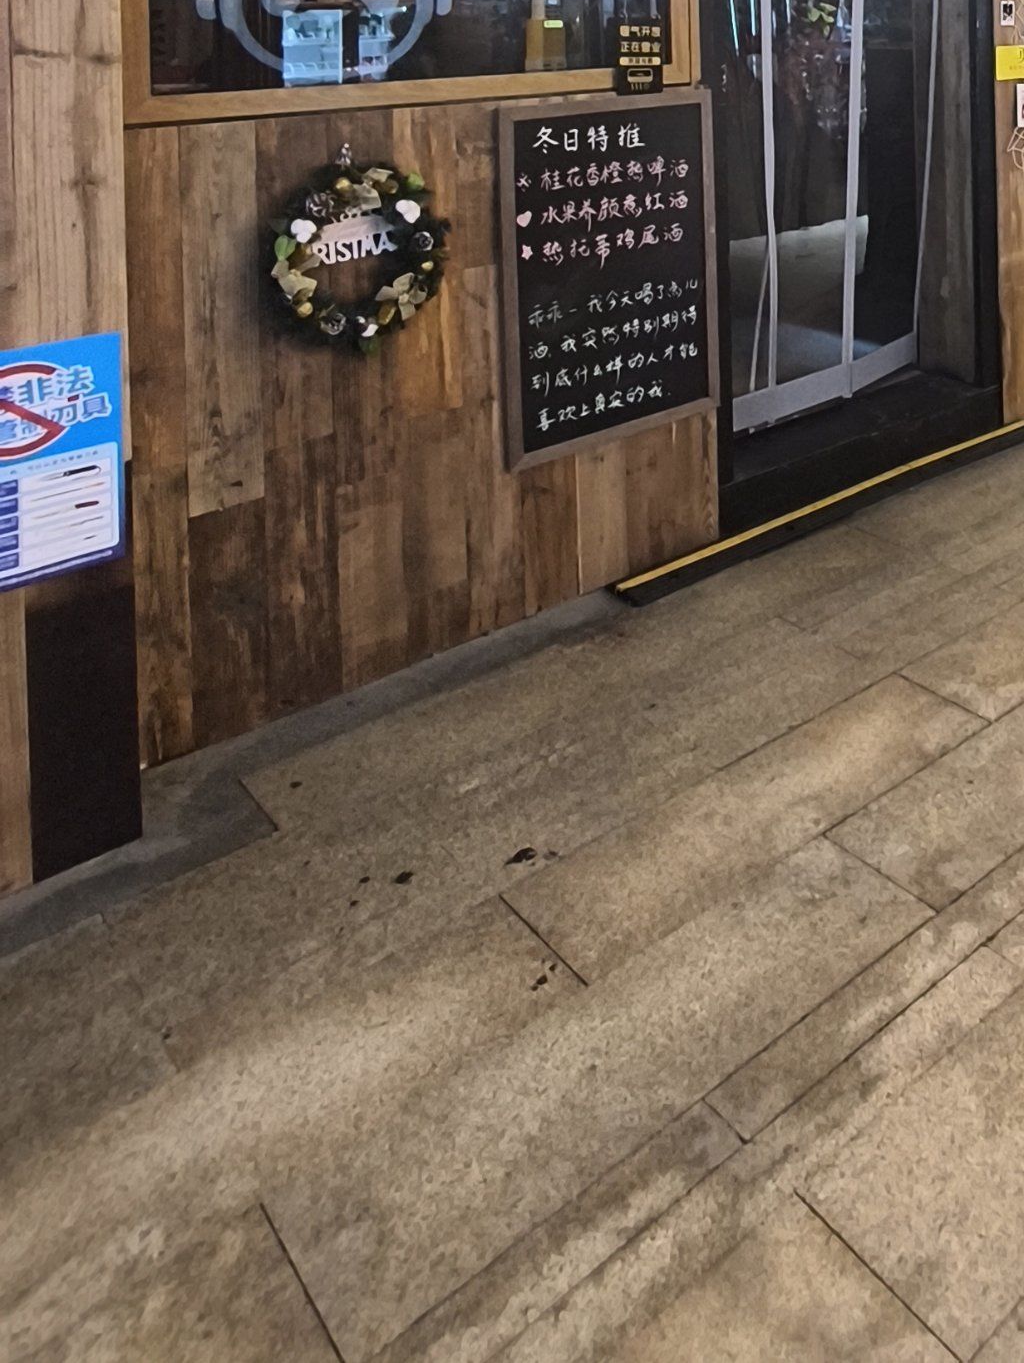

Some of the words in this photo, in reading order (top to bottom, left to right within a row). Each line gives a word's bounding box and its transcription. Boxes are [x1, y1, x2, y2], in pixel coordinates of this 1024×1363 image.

[532, 122, 646, 155] 冬日特推
[540, 155, 690, 193] 桂花香橙热啤酒
[540, 189, 690, 233] 水果养颜煮红酒
